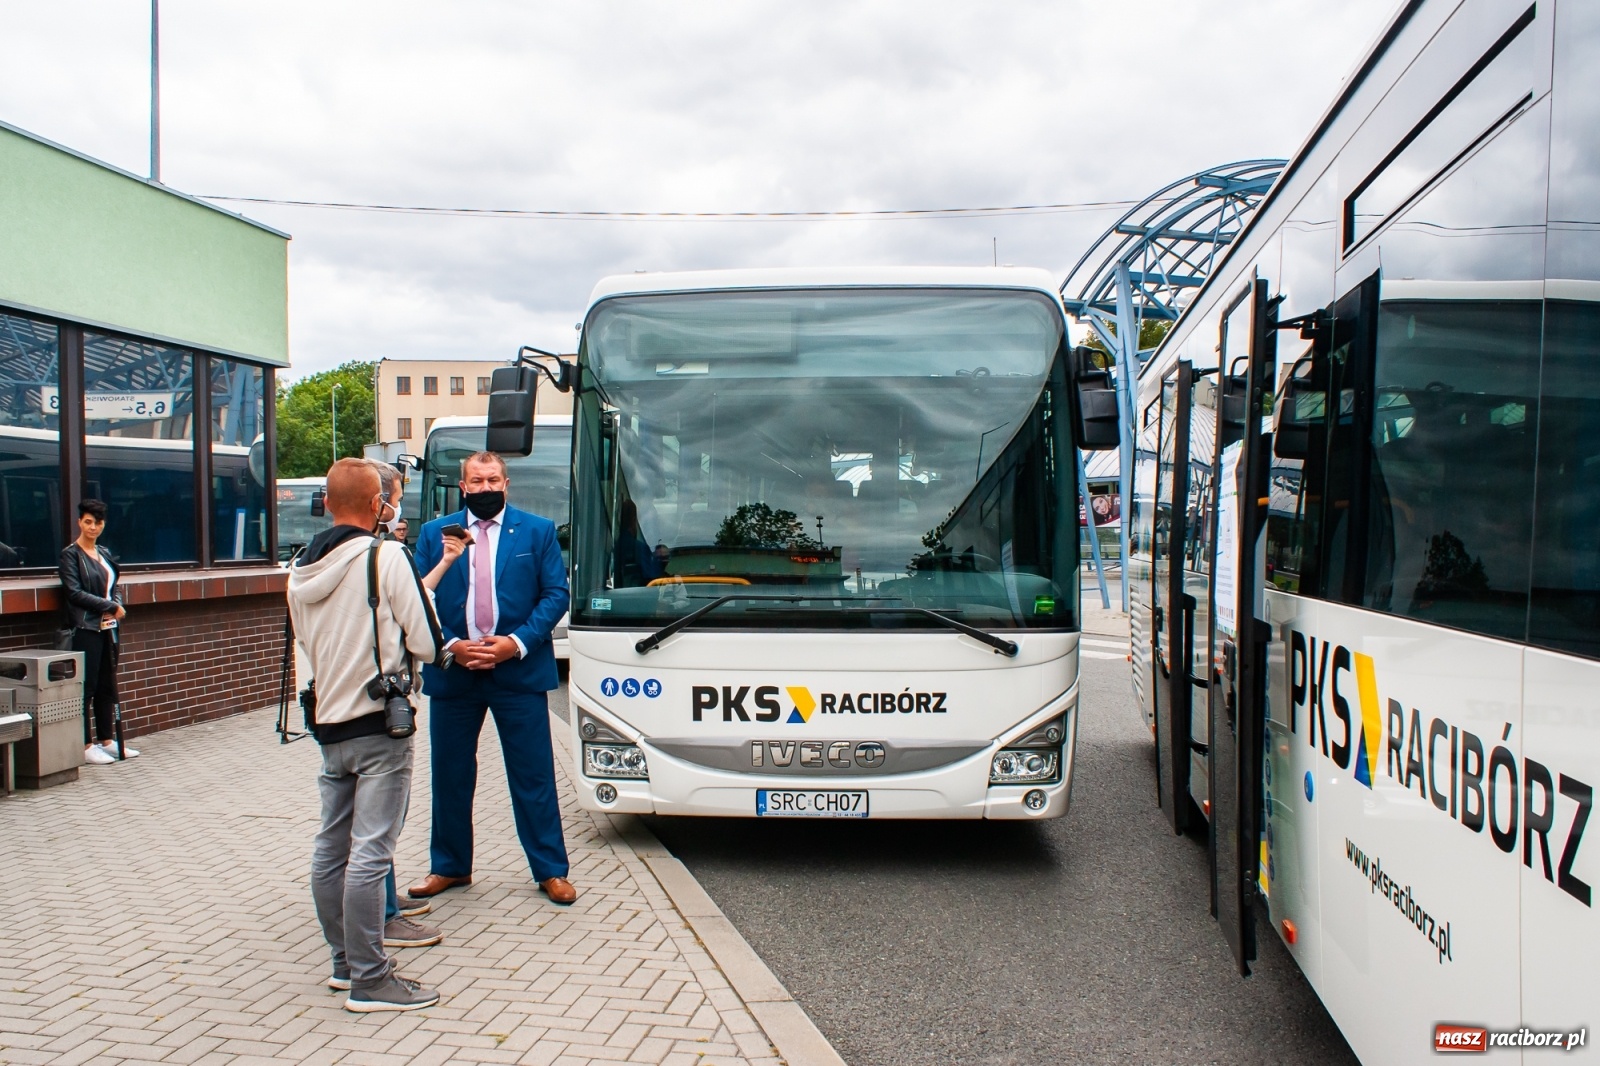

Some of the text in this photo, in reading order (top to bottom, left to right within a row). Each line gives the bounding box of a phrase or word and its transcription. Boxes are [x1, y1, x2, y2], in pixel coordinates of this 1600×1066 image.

[692, 685, 947, 722] PKS RACIBÓRZ
[751, 740, 886, 768] IVECO
[1290, 629, 1593, 908] PKS RACIBÓRZ
[770, 793, 806, 811] SRC
[814, 793, 862, 811] CH07
[1345, 836, 1453, 965] www.pksraciborz.pl
